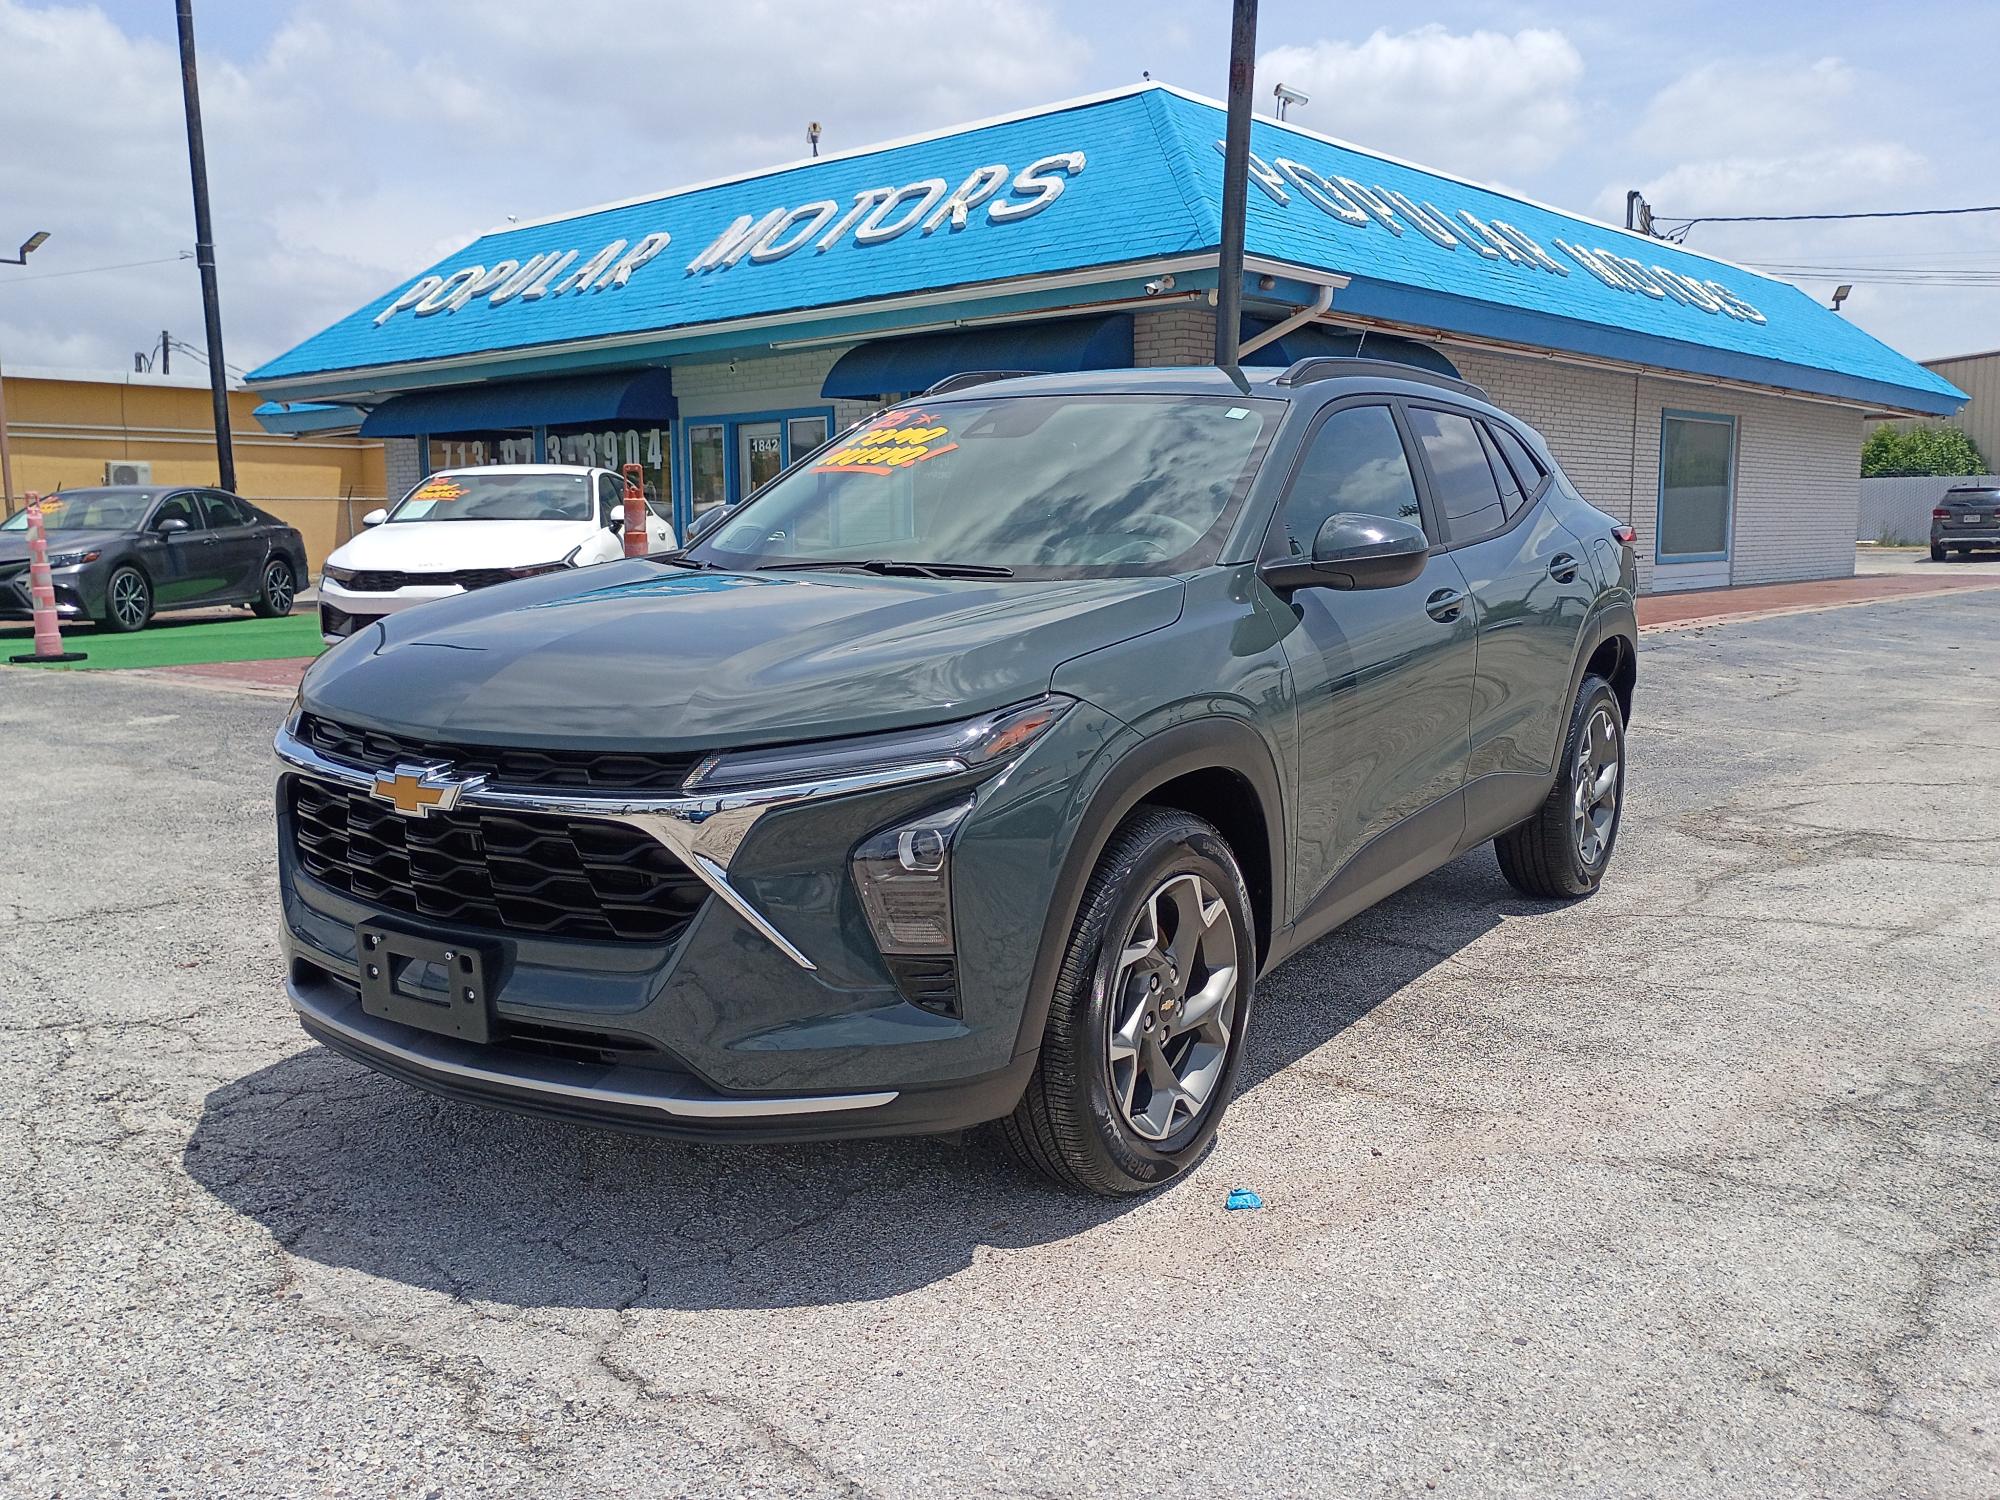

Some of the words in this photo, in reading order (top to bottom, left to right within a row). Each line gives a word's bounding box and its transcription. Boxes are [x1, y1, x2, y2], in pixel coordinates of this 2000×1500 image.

[373, 231, 672, 326] POPULAR
[685, 151, 1087, 275] MOTORS
[1212, 140, 1571, 277] POPULAR
[752, 439, 778, 452] 1842
